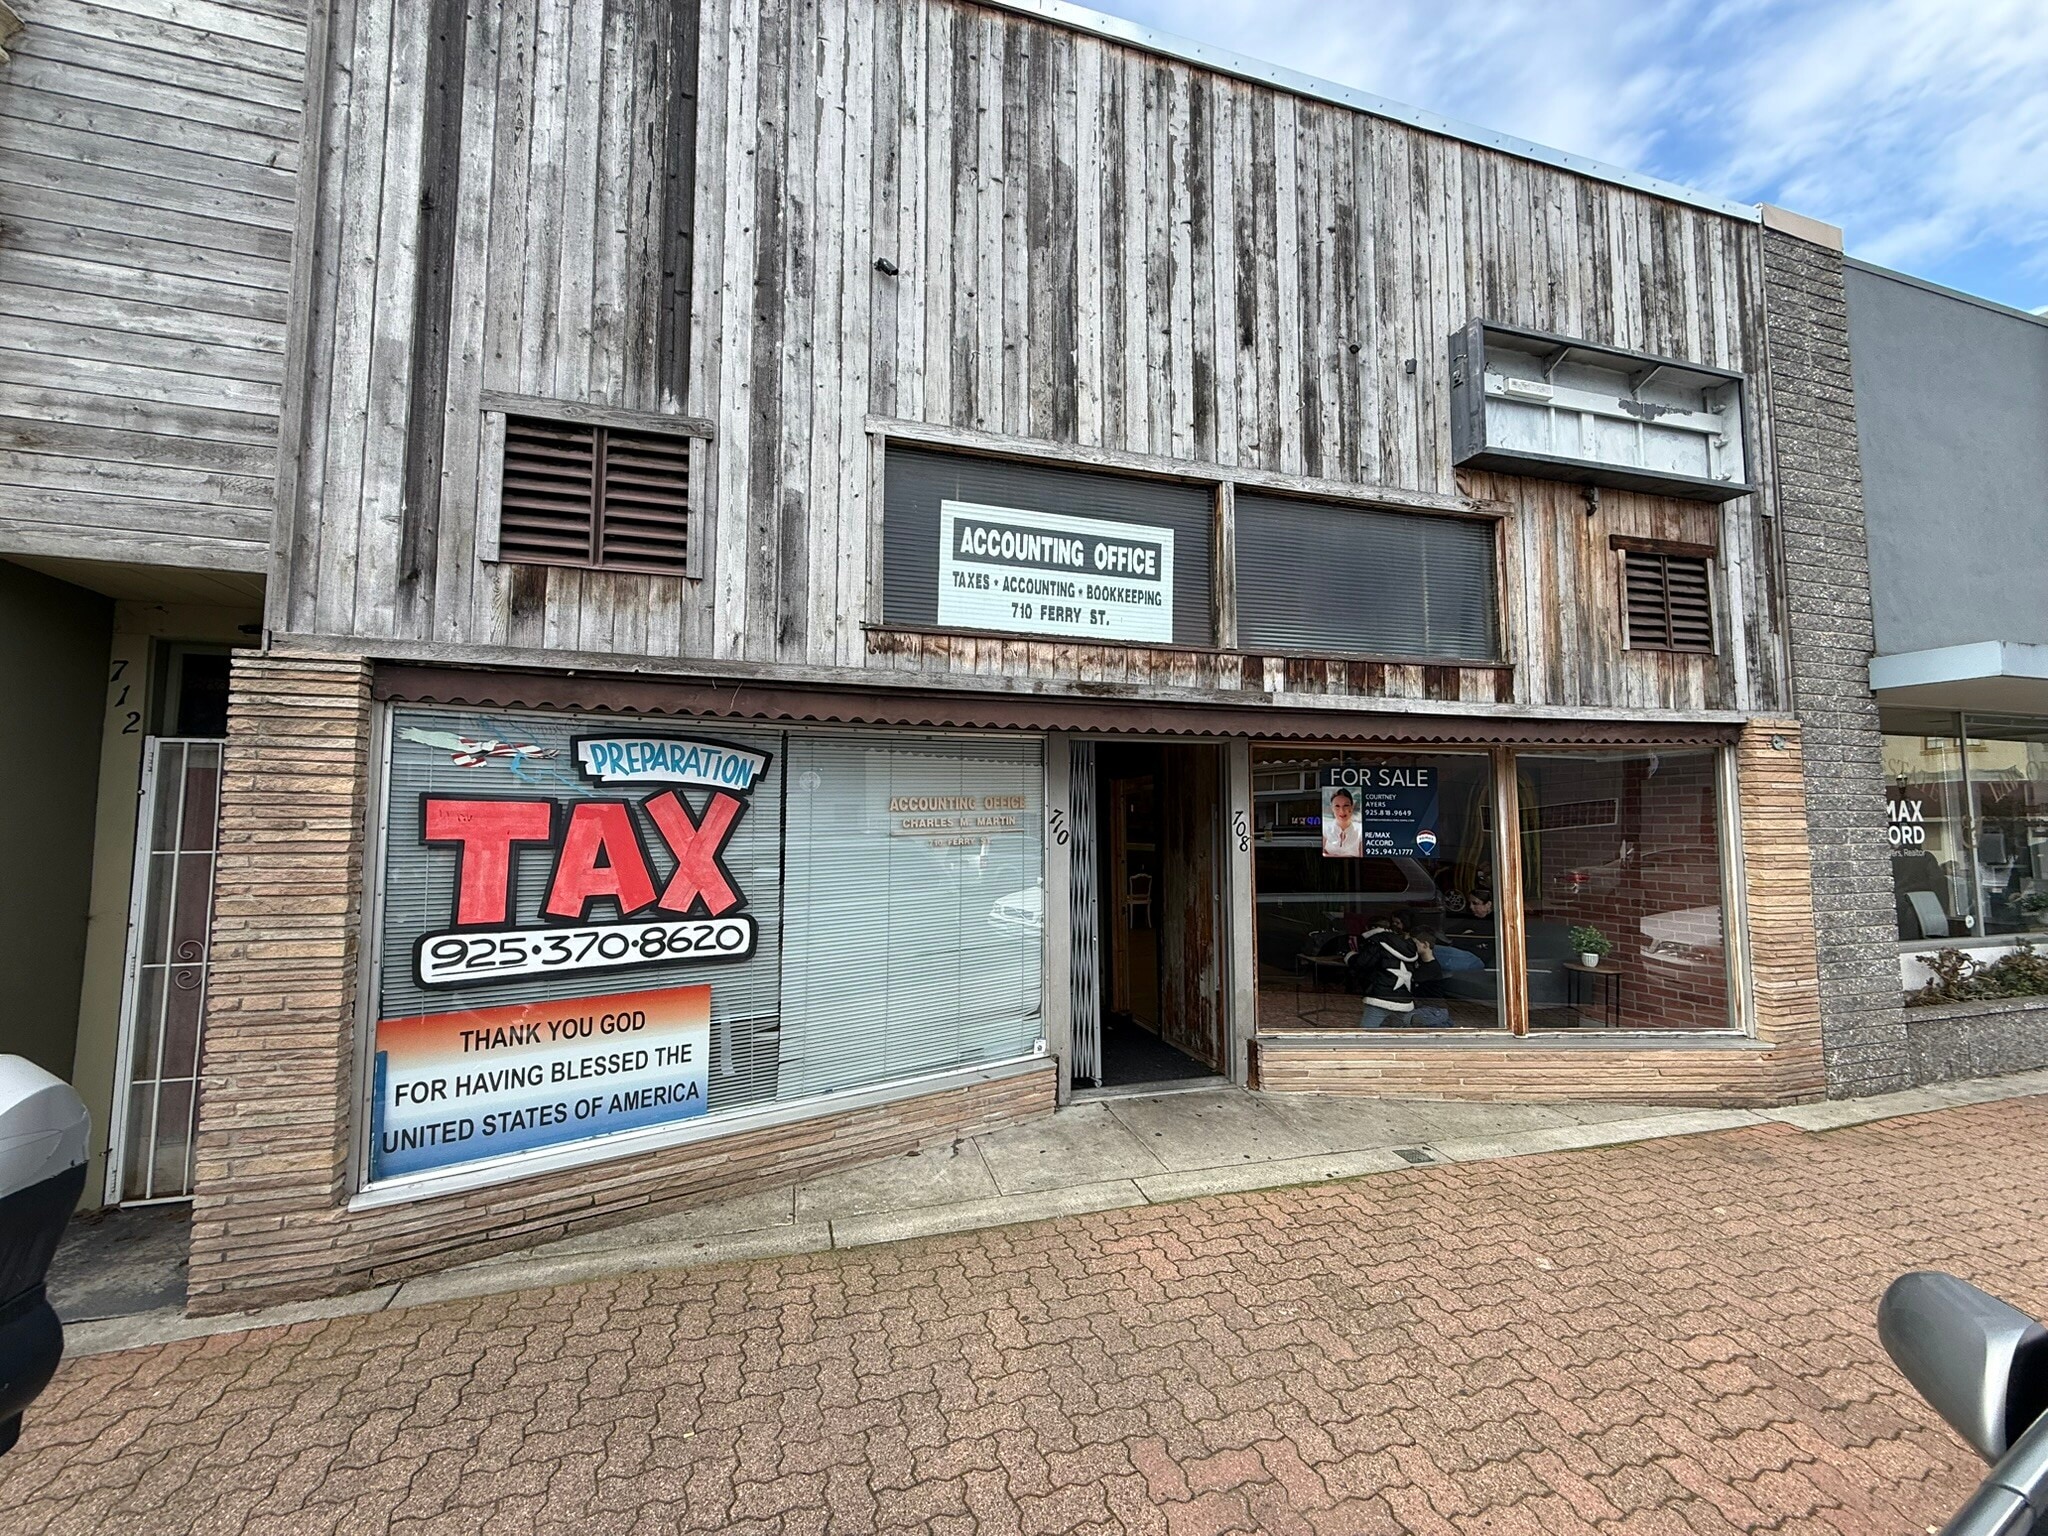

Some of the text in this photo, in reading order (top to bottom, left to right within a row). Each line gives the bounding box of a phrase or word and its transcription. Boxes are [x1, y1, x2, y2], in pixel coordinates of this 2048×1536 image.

[960, 526, 1156, 576] ACCOUNTING OFFICE
[952, 571, 1162, 606] TAXES ACCOUNTING BOOKKEEPING
[1011, 602, 1110, 626] 710 FERRY ST.
[110, 659, 141, 735] 712
[589, 742, 756, 787] PREPARATION
[1330, 768, 1429, 787] FOR SALE
[889, 795, 1027, 812] ACCOUNTING OFFICE
[902, 818, 954, 829] CHARLES
[976, 816, 1016, 827] MARTIN
[1050, 808, 1070, 846] 710
[1232, 810, 1251, 852] 708
[1364, 831, 1391, 839] RE/MAX
[421, 787, 747, 927] TAX
[947, 837, 976, 846] FERRY
[1366, 839, 1394, 847] ACCORD
[1366, 848, 1414, 856] 925.947.1777
[459, 1010, 646, 1052] THANK YOU GOD
[395, 1044, 693, 1107] FOR HAVING BLESSED THE
[382, 1081, 700, 1154] UNITED STATES OF AMERICA
